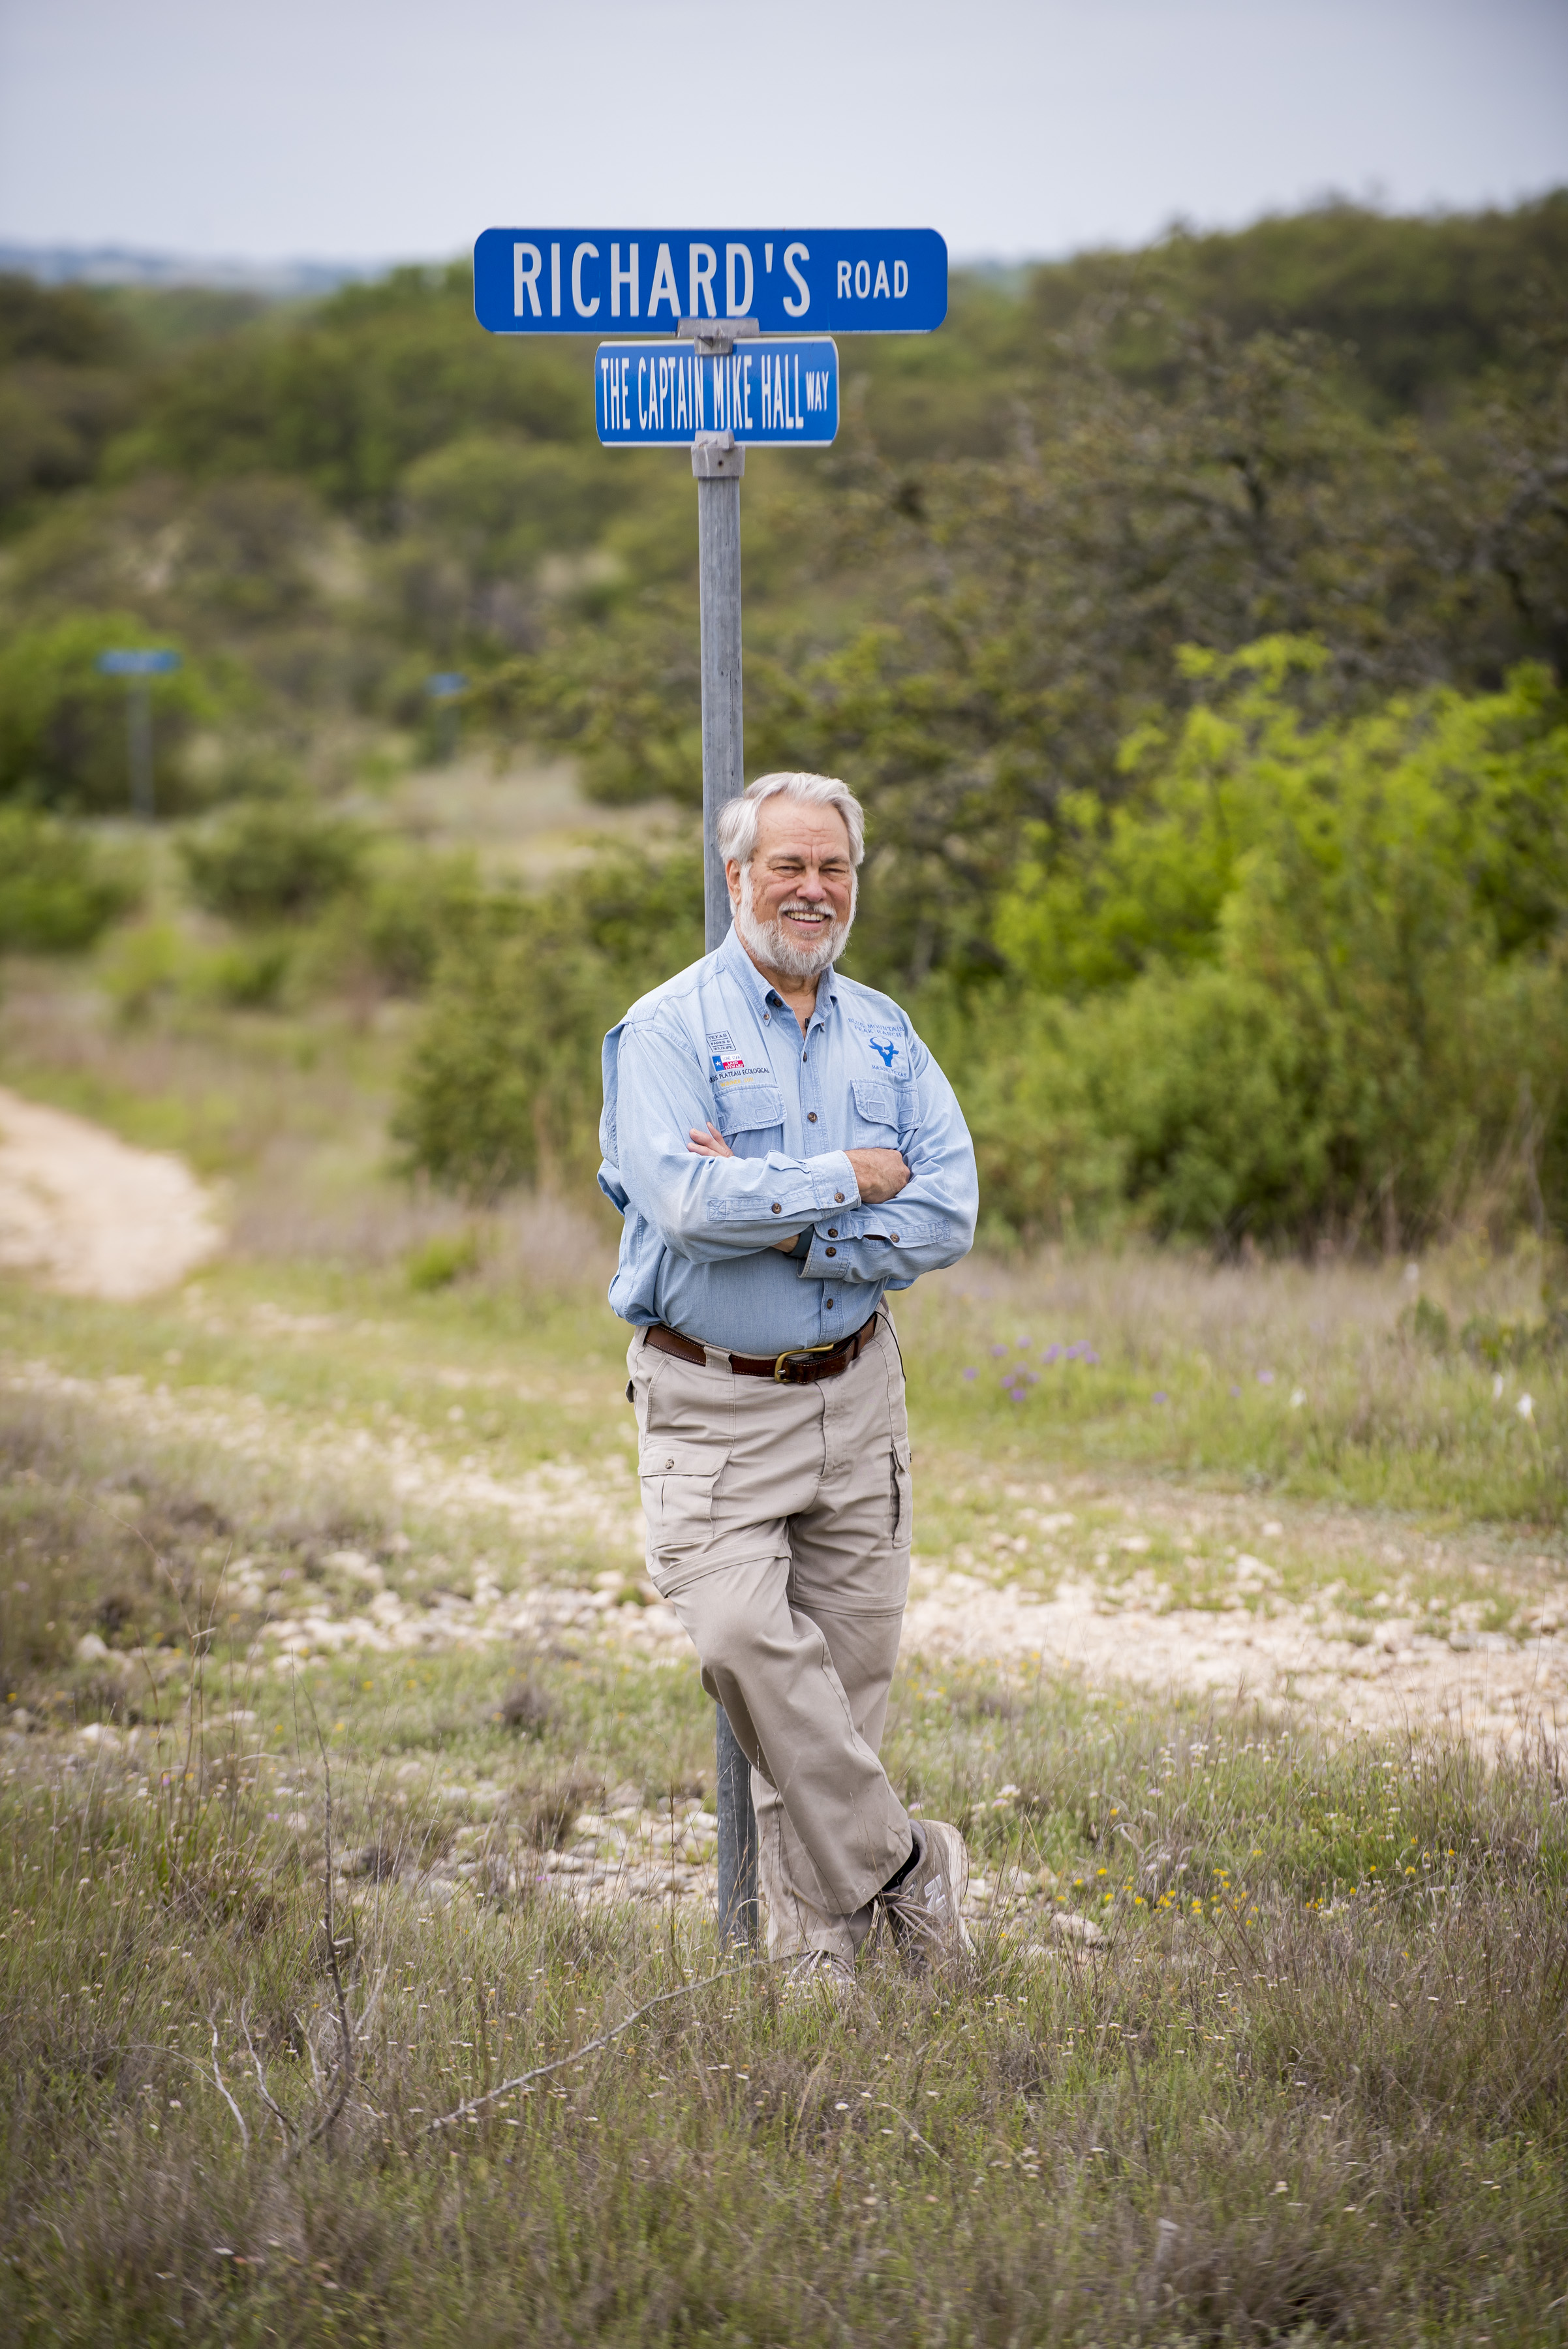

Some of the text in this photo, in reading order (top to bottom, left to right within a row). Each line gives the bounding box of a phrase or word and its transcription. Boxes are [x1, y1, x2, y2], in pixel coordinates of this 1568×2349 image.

[513, 242, 908, 317] RICHARD'S ROAD
[601, 354, 829, 431] THE CAPTAIN MIKE HALL WAY
[848, 1018, 865, 1028] BLUE
[854, 1025, 874, 1034] PEAK
[719, 1070, 741, 1079] PLATEAU
[891, 1069, 907, 1078] TEXAS
